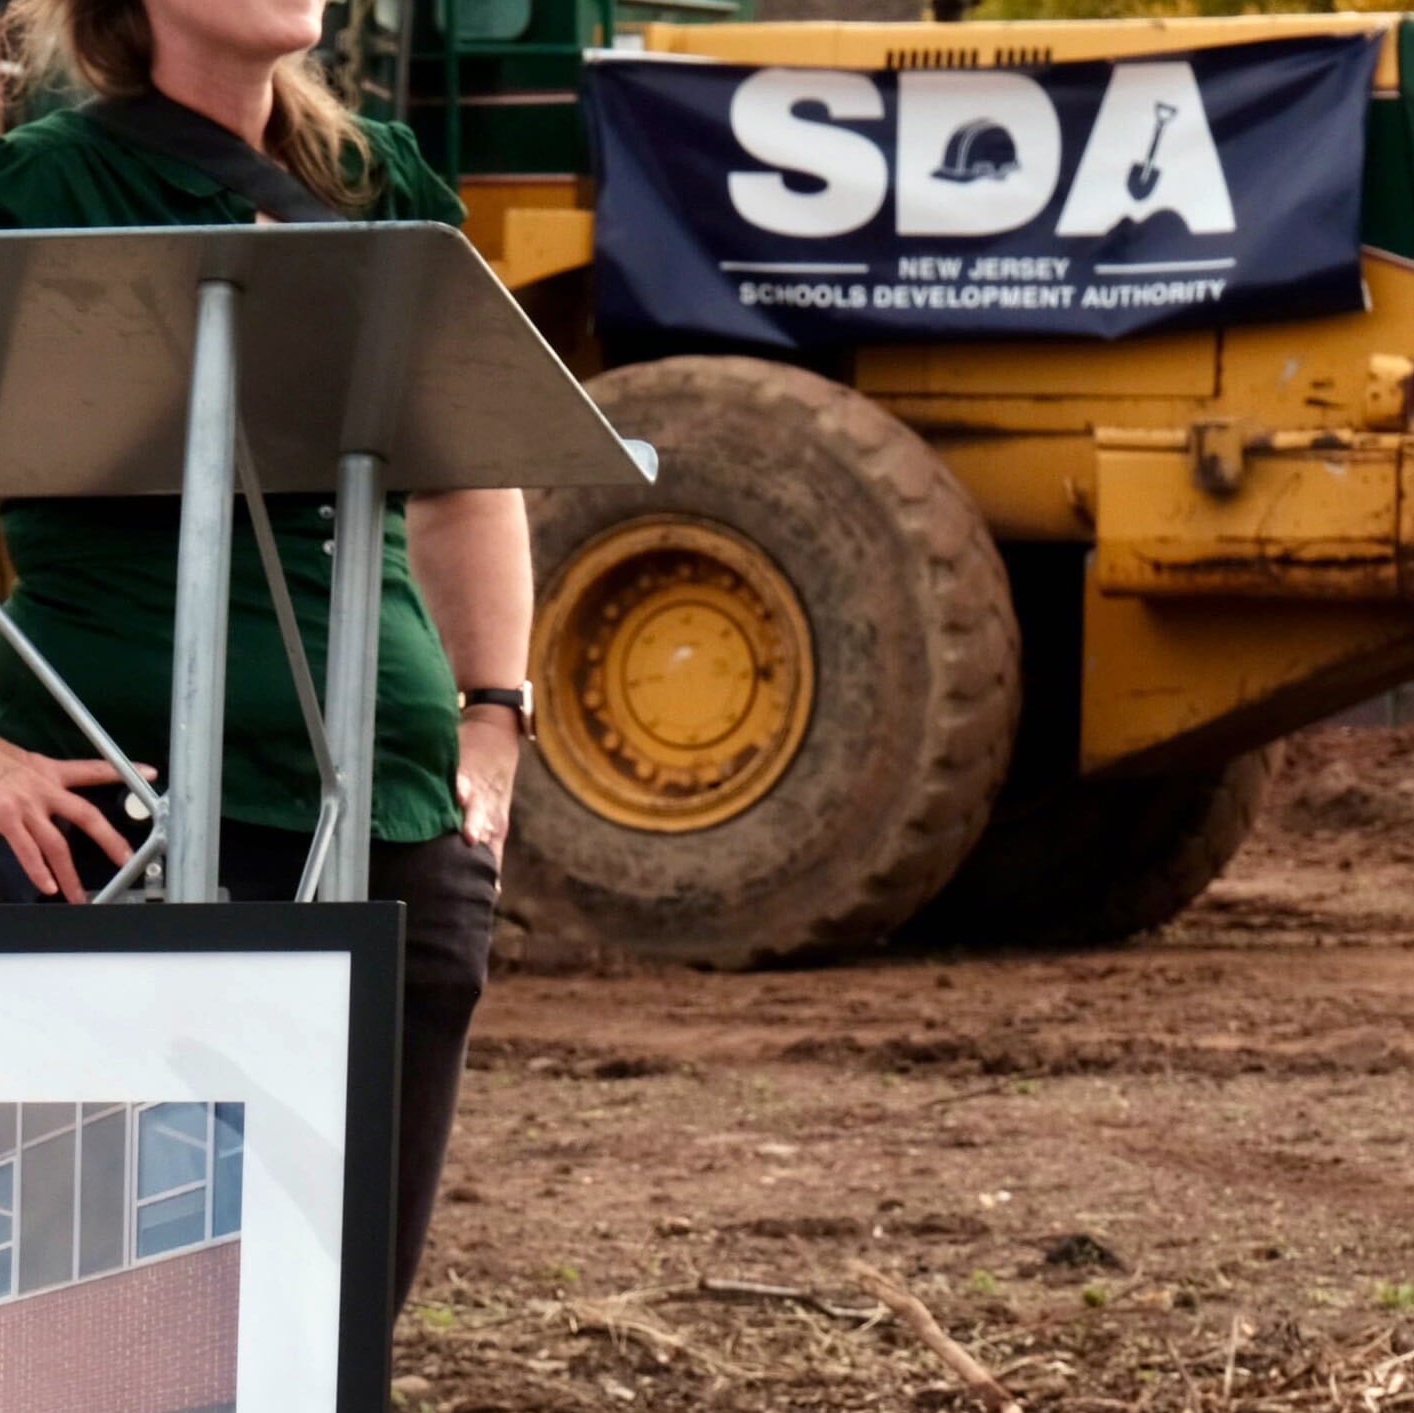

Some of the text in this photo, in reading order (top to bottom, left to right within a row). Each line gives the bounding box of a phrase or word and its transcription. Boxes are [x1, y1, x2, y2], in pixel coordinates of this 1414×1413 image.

[727, 62, 1237, 238] SDA
[898, 257, 1071, 281] NEW JERSEY
[739, 279, 1226, 309] SCHOOLS DEVELOPMENT AUTHORITY
